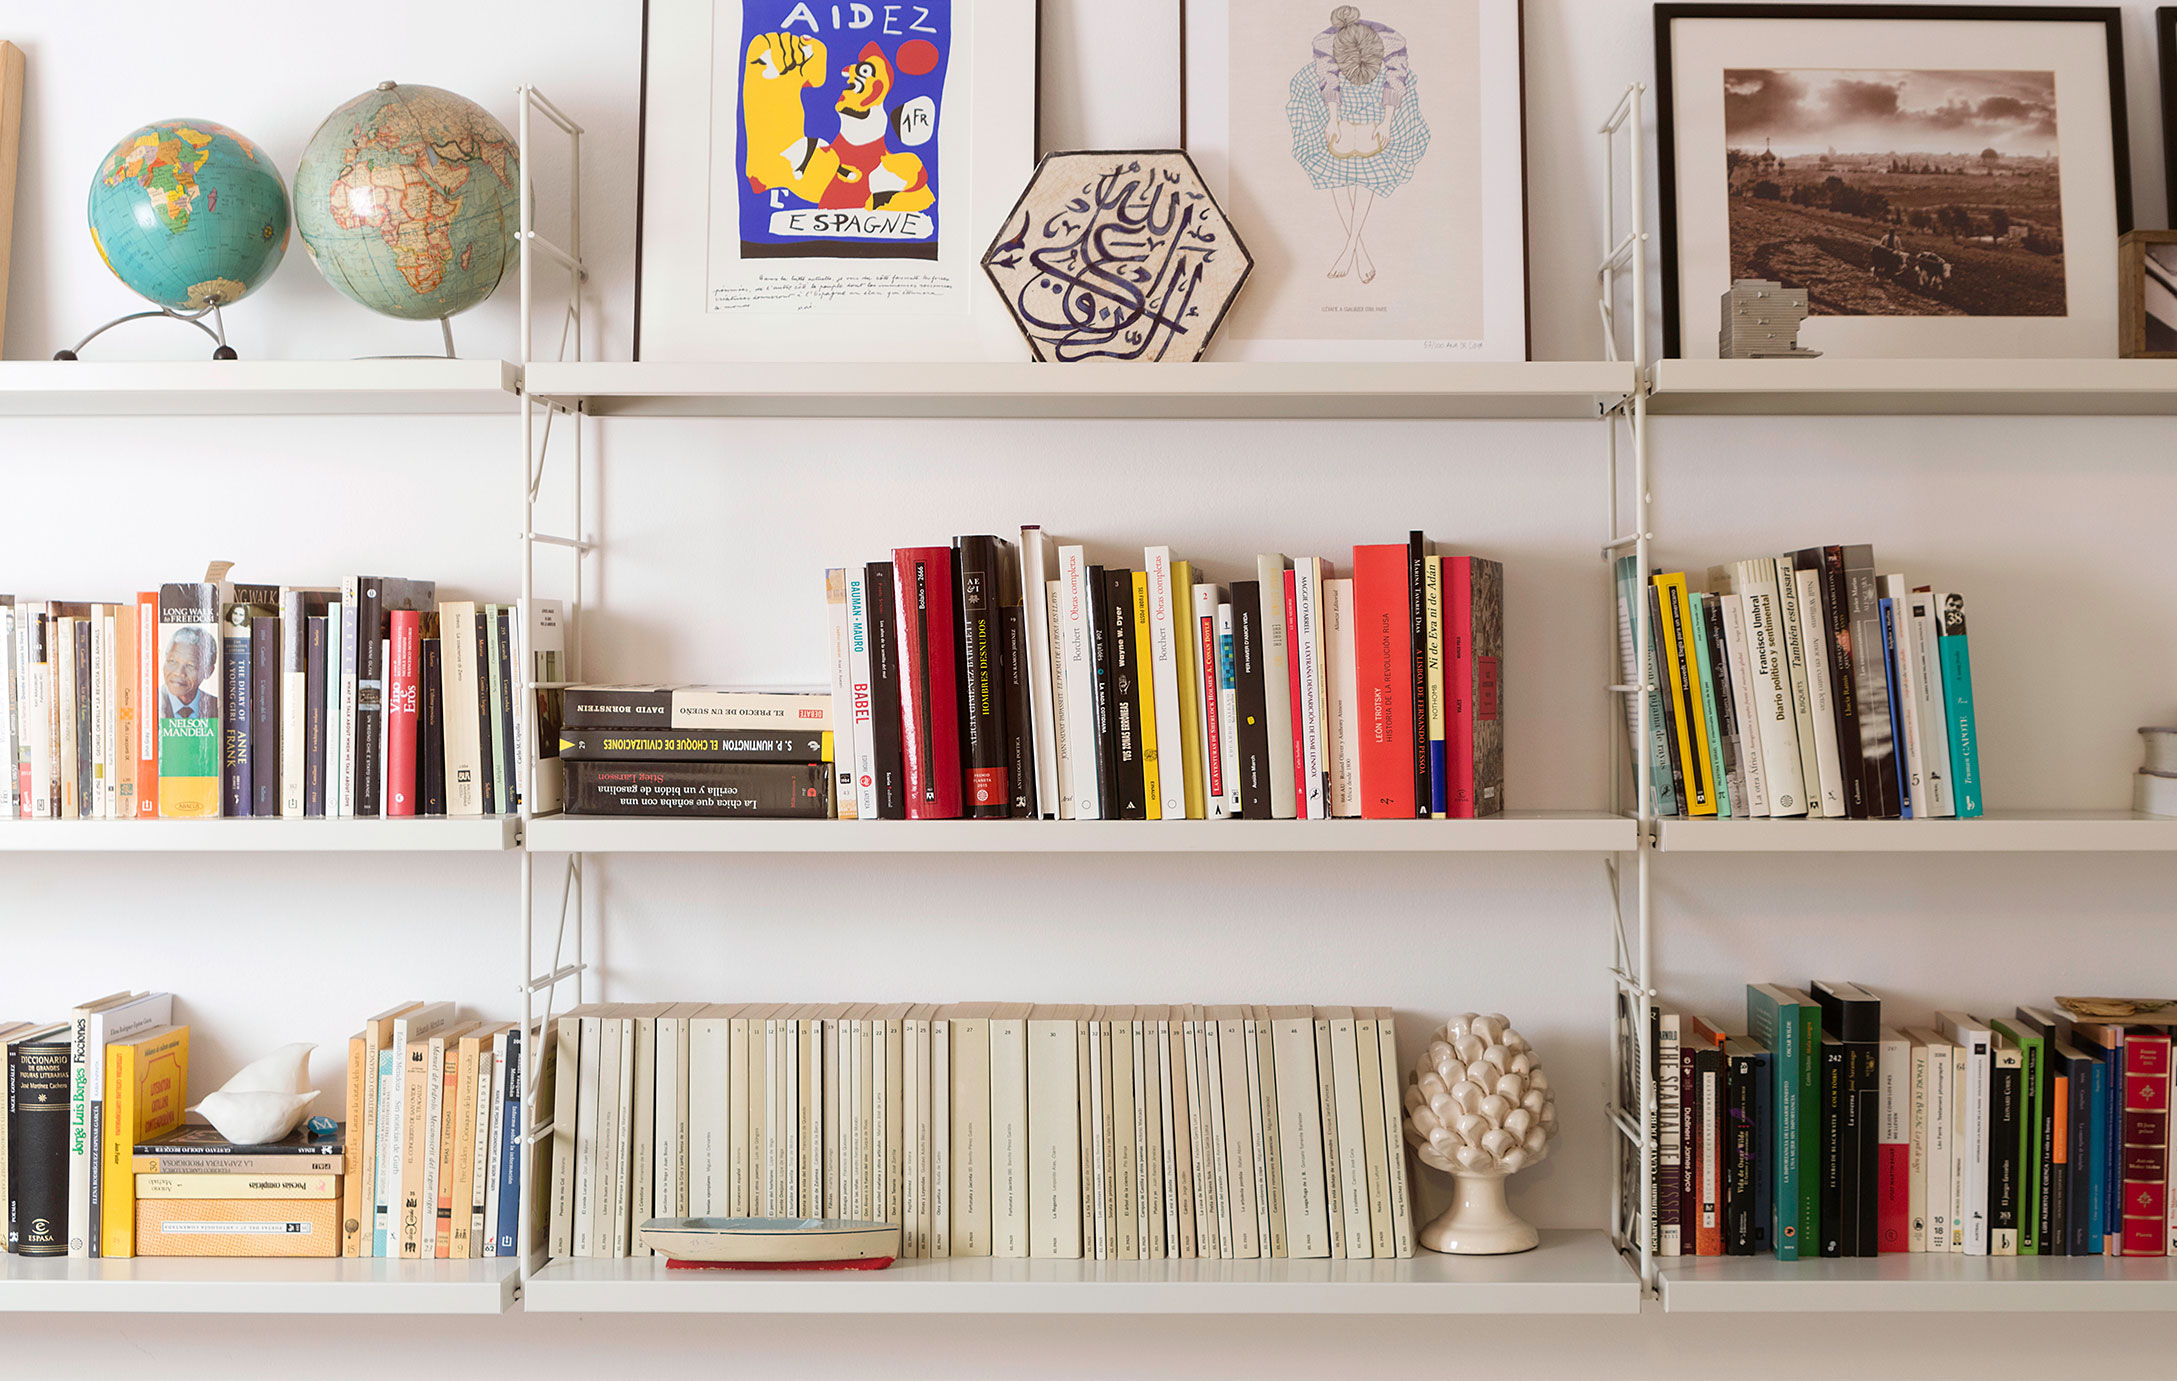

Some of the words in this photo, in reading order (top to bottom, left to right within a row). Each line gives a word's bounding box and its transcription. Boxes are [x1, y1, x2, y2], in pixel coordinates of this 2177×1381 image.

[781, 2, 936, 34] AIDEZ
[789, 213, 921, 235] ESPAGNE
[917, 566, 925, 581] 2666
[1068, 555, 1079, 596] completas
[1154, 555, 1165, 596] completas
[1426, 564, 1436, 591] Adán
[1782, 566, 1795, 600] pasará
[851, 581, 862, 616] BAUMAN
[917, 589, 926, 610] Bolaño
[1070, 597, 1080, 620] Obras
[1156, 597, 1166, 620] Obras
[1428, 592, 1437, 606] de
[163, 608, 188, 616] LONG
[189, 608, 214, 616] WALK
[1115, 606, 1124, 626] Dyer
[1428, 608, 1436, 618] ni
[1750, 595, 1762, 628] Umbral
[1761, 594, 1776, 648] sentimental
[1788, 601, 1798, 623] esto
[853, 622, 864, 652] MAURO
[1116, 627, 1124, 638] W.
[1428, 620, 1438, 640] Eva
[344, 610, 354, 674] CARVER
[977, 619, 988, 669] DESNUDOS
[1072, 628, 1082, 662] Borchert
[1117, 639, 1126, 667] Wayne
[1157, 628, 1168, 662] Borchert
[1428, 642, 1438, 656] de
[1756, 630, 1769, 675] Francisco
[1790, 625, 1802, 669] También
[1382, 635, 1392, 682] REVOLUCIÓN
[1428, 657, 1438, 670] Ni
[1770, 656, 1782, 692] político
[238, 680, 246, 706] DIARY
[390, 682, 401, 714] Vino
[403, 685, 416, 712] Eros
[979, 670, 990, 716] HOMBRES
[1206, 674, 1214, 701] HOLMES
[1384, 684, 1391, 694] LA
[1797, 680, 1806, 714] BUSQUETS
[577, 705, 631, 714] BORNSTEIN
[636, 706, 665, 714] DAVID
[854, 683, 869, 724] BABEL
[1374, 688, 1382, 721] TROTSKY
[1384, 695, 1392, 706] DE
[1648, 694, 1660, 728] pijama
[1774, 694, 1785, 720] Diario
[169, 718, 209, 728] NELSON
[238, 709, 246, 722] OF
[680, 708, 709, 717] SUEÑO
[799, 710, 823, 718] DEBATE
[1119, 702, 1131, 731] ERRÓNEAS
[1207, 702, 1216, 733] SHERLOCK
[163, 728, 215, 737] MANDELA
[1374, 722, 1383, 742] LEÓN
[1384, 707, 1393, 742] HISTORIA
[1654, 730, 1662, 741] de
[603, 739, 663, 750] CIVILIZACIONES
[664, 740, 675, 750] DE
[678, 739, 708, 750] CHOQUE
[710, 740, 718, 750] EL
[722, 740, 774, 751] HUNTINGTON
[776, 740, 782, 751] P.
[785, 740, 792, 751] S.
[1121, 732, 1132, 750] ZONAS
[1210, 734, 1216, 742] DE
[1960, 716, 1970, 756] CAPOTE
[226, 729, 236, 768] FRANK
[237, 731, 247, 764] ANNE
[1122, 751, 1132, 762] TUS
[1655, 744, 1667, 770] rayas
[1210, 744, 1219, 779] AVENTURAS
[1964, 758, 1972, 784] Truman
[598, 774, 636, 783] Larsson
[639, 773, 664, 783] Stieg
[598, 784, 638, 796] gasolina
[640, 787, 652, 796] de
[654, 786, 681, 796] bidón
[699, 785, 705, 794] y
[707, 787, 738, 796] cerilla
[660, 798, 694, 809] soñaba
[696, 797, 714, 807] que
[717, 799, 742, 809] chica
[744, 800, 757, 809] La
[74, 1018, 86, 1064] Ficciones
[21, 1056, 68, 1064] DICCIONARIO
[432, 1046, 440, 1070] Manuel
[1660, 1045, 1678, 1068] THE
[74, 1068, 86, 1102] Borges
[394, 1060, 403, 1092] Mendoza
[432, 1072, 439, 1082] de
[394, 1102, 402, 1112] Sin
[430, 1084, 438, 1112] Pedrolo.
[1660, 1076, 1678, 1136] SCANDAL
[73, 1104, 84, 1126] Luis
[394, 1114, 402, 1138] noticias
[1684, 1108, 1692, 1140] Dubliners
[72, 1128, 86, 1155] Jorge
[393, 1138, 400, 1149] de
[428, 1116, 438, 1155] Mecanoscrit
[428, 1157, 436, 1167] del
[1660, 1144, 1678, 1160] OF
[1684, 1146, 1692, 1169] James
[426, 1170, 434, 1189] segon
[1683, 1170, 1692, 1192] Joyce
[426, 1190, 434, 1214] origen
[1660, 1166, 1678, 1224] ULYSSES
